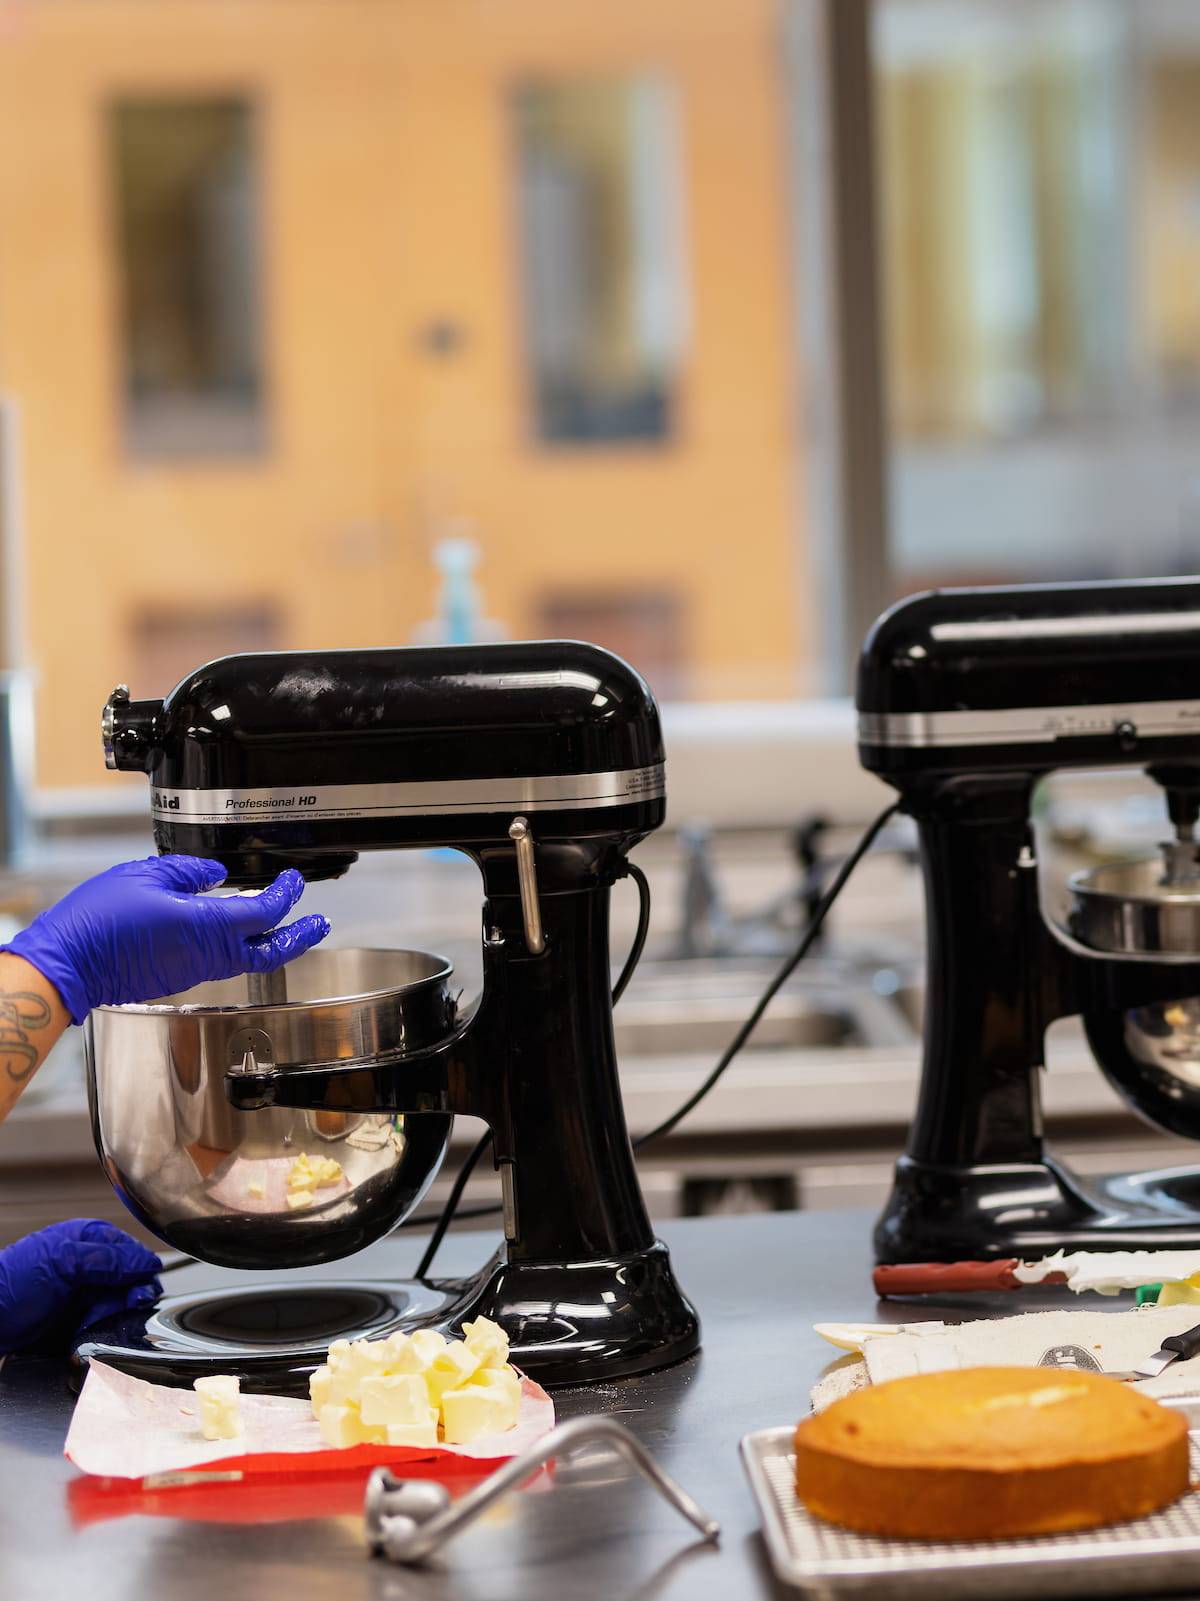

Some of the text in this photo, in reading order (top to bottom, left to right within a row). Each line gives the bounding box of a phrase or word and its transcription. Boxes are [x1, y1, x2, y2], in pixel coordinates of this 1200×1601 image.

[153, 792, 317, 809] Aid Professional HD
